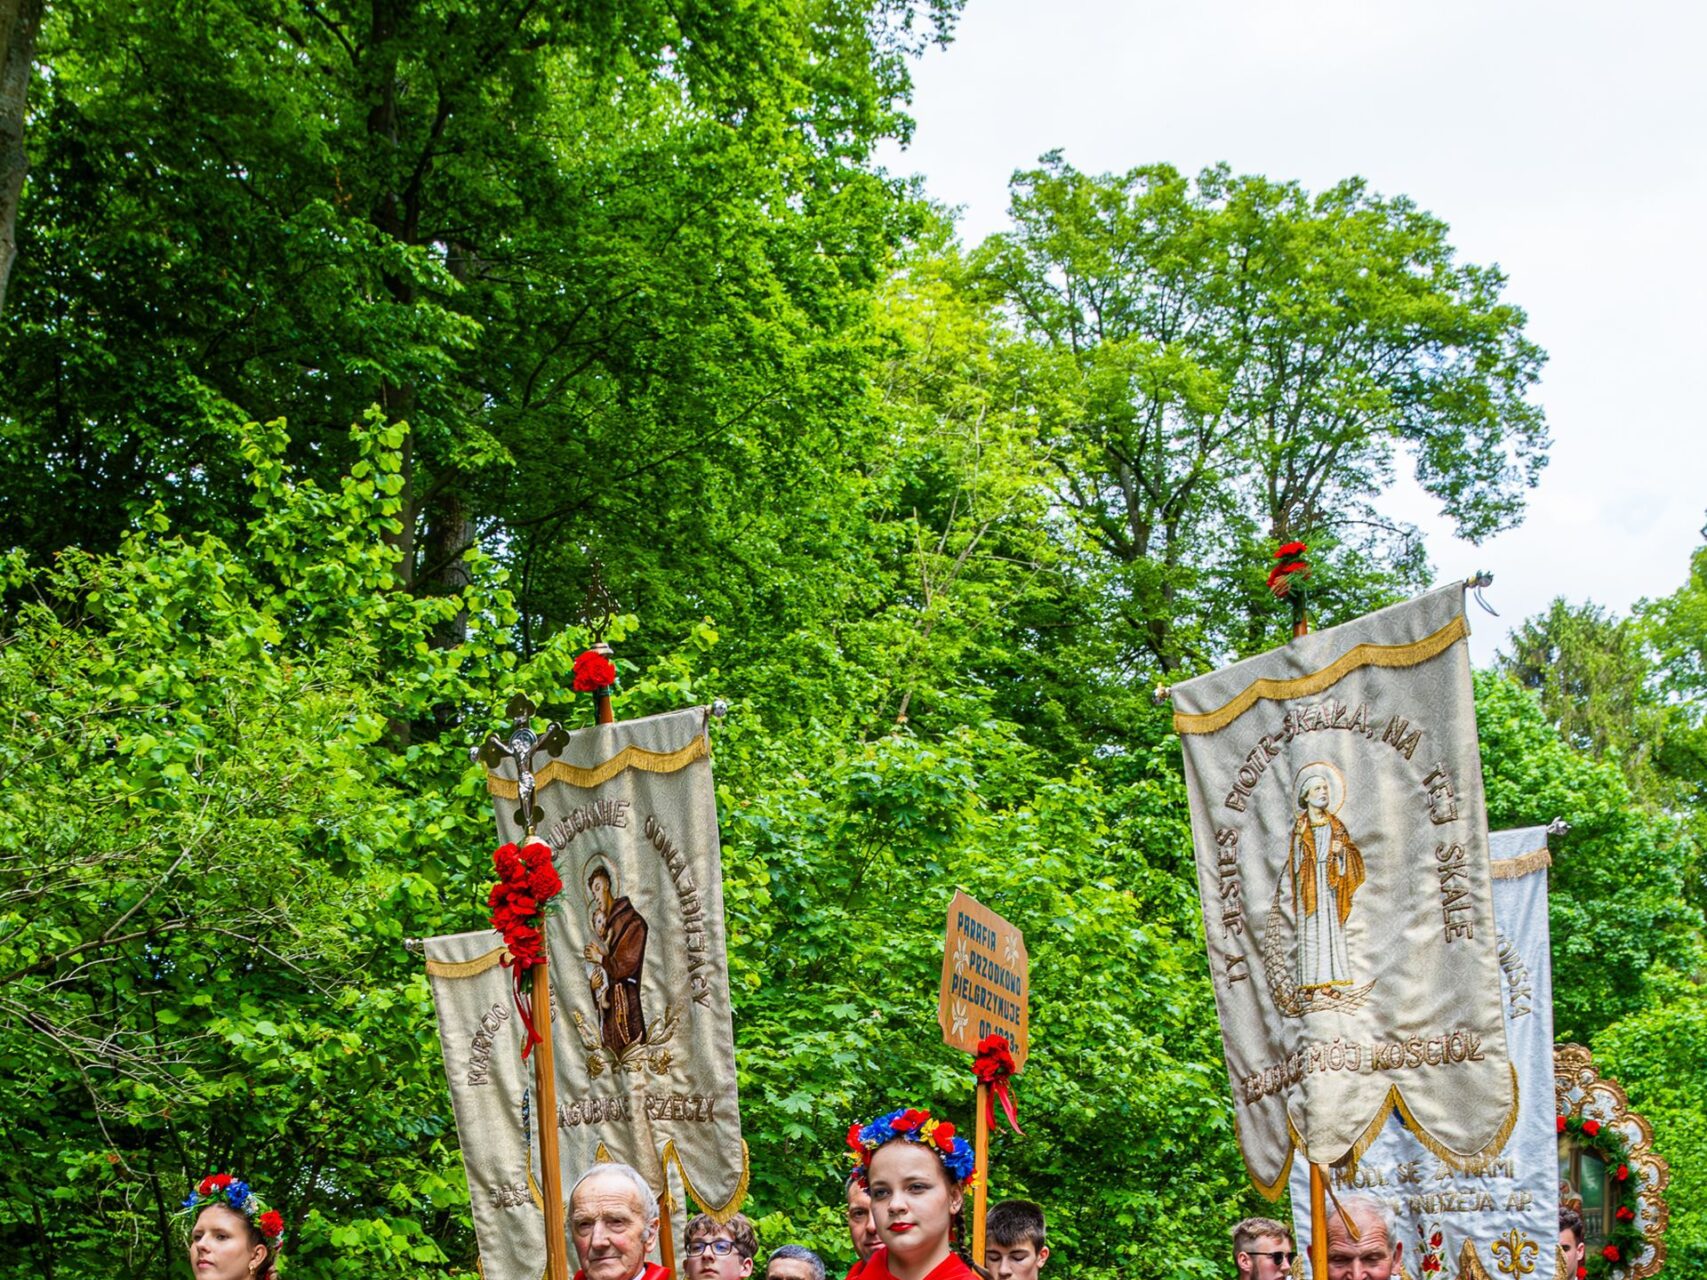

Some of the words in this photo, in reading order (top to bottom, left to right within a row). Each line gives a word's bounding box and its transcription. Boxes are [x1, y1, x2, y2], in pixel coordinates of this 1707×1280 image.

[1382, 715, 1422, 760] NA
[1422, 762, 1458, 825] TEJ
[1435, 841, 1474, 943] SKALE
[957, 912, 996, 952] PARAFIA
[969, 950, 1021, 996] PRZODKOWO
[1223, 953, 1248, 989] TY
[1496, 934, 1532, 1019] OWSKA
[951, 973, 1020, 1026] PIELGRZYMUJE
[468, 1002, 510, 1087] MARYJO
[1308, 1037, 1361, 1073] MÓJ
[1372, 1030, 1485, 1071] KOŚCIÓŁ
[643, 1093, 716, 1123] RZECZY
[1505, 1190, 1533, 1212] AP.
